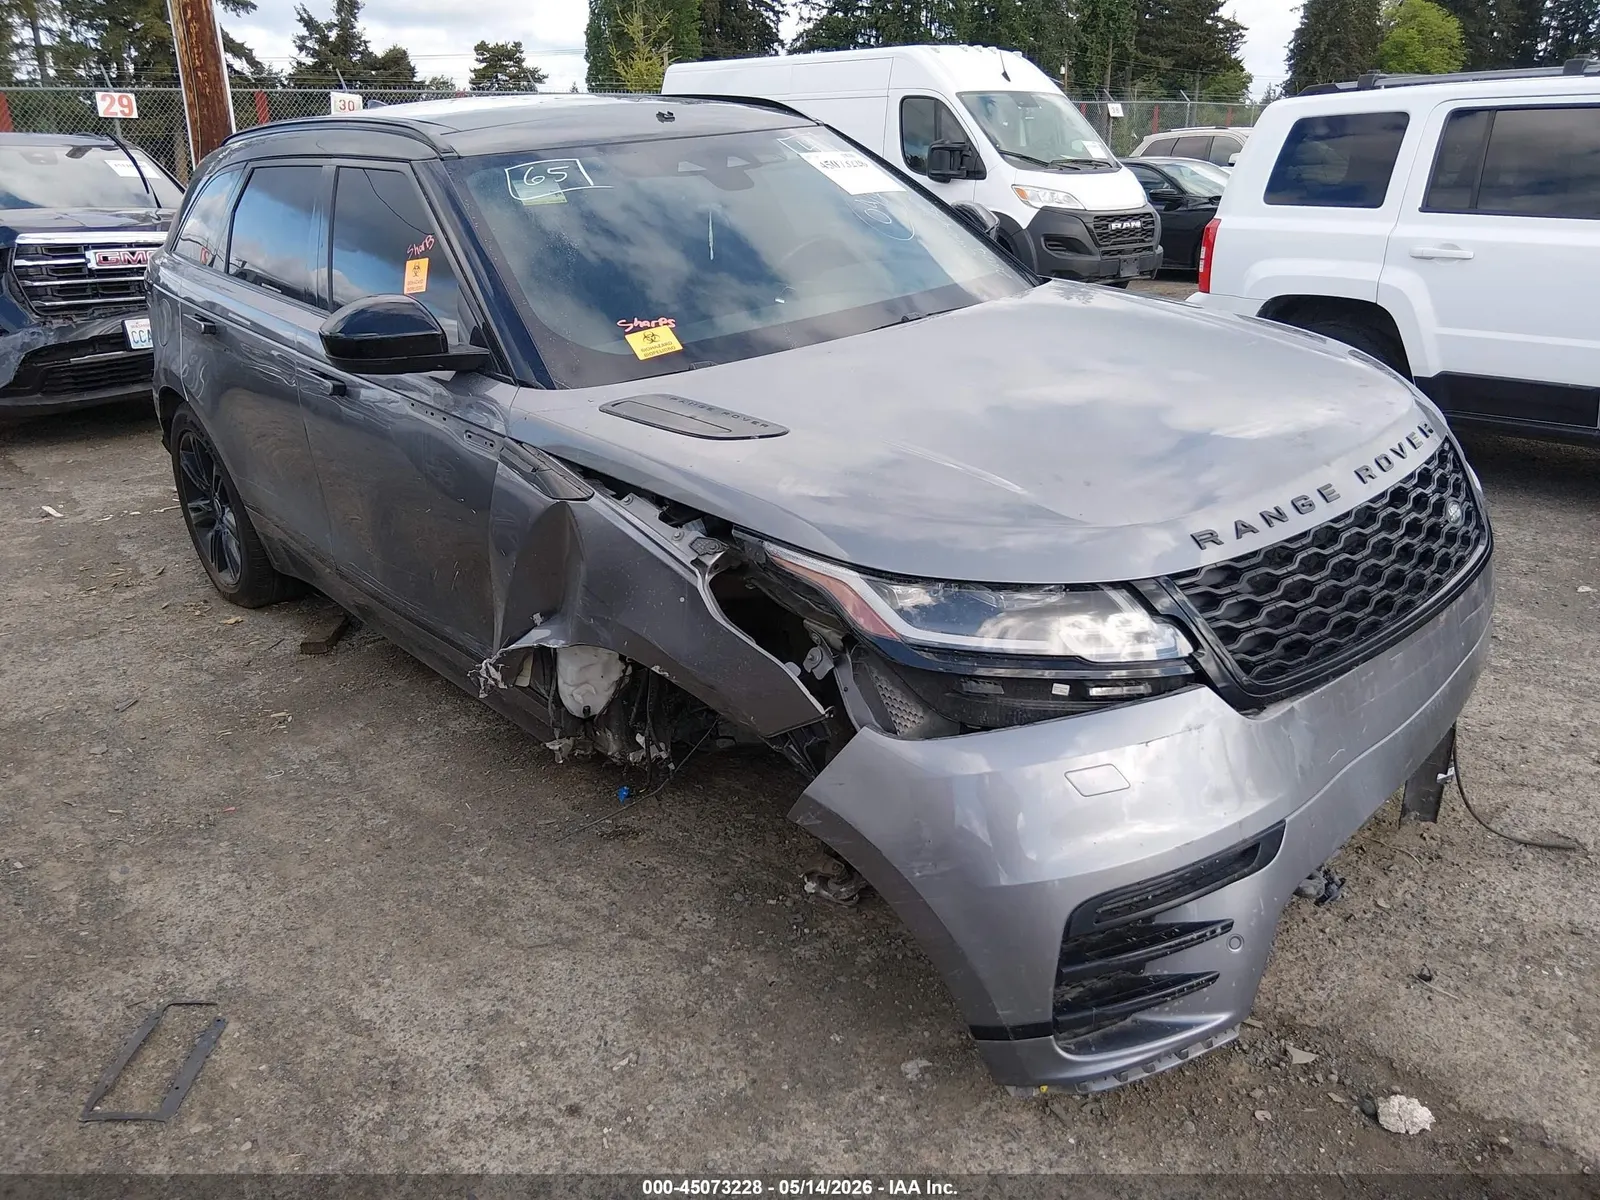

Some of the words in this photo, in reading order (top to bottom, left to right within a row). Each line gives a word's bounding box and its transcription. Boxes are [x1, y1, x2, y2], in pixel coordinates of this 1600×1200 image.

[100, 93, 134, 117] 29
[338, 99, 355, 112] 30
[523, 165, 570, 186] 65
[1111, 221, 1141, 230] RAM
[669, 397, 716, 412] RANGE
[721, 411, 769, 428] ROVER
[1190, 483, 1341, 550] RANGE
[1353, 420, 1436, 484] ROVER
